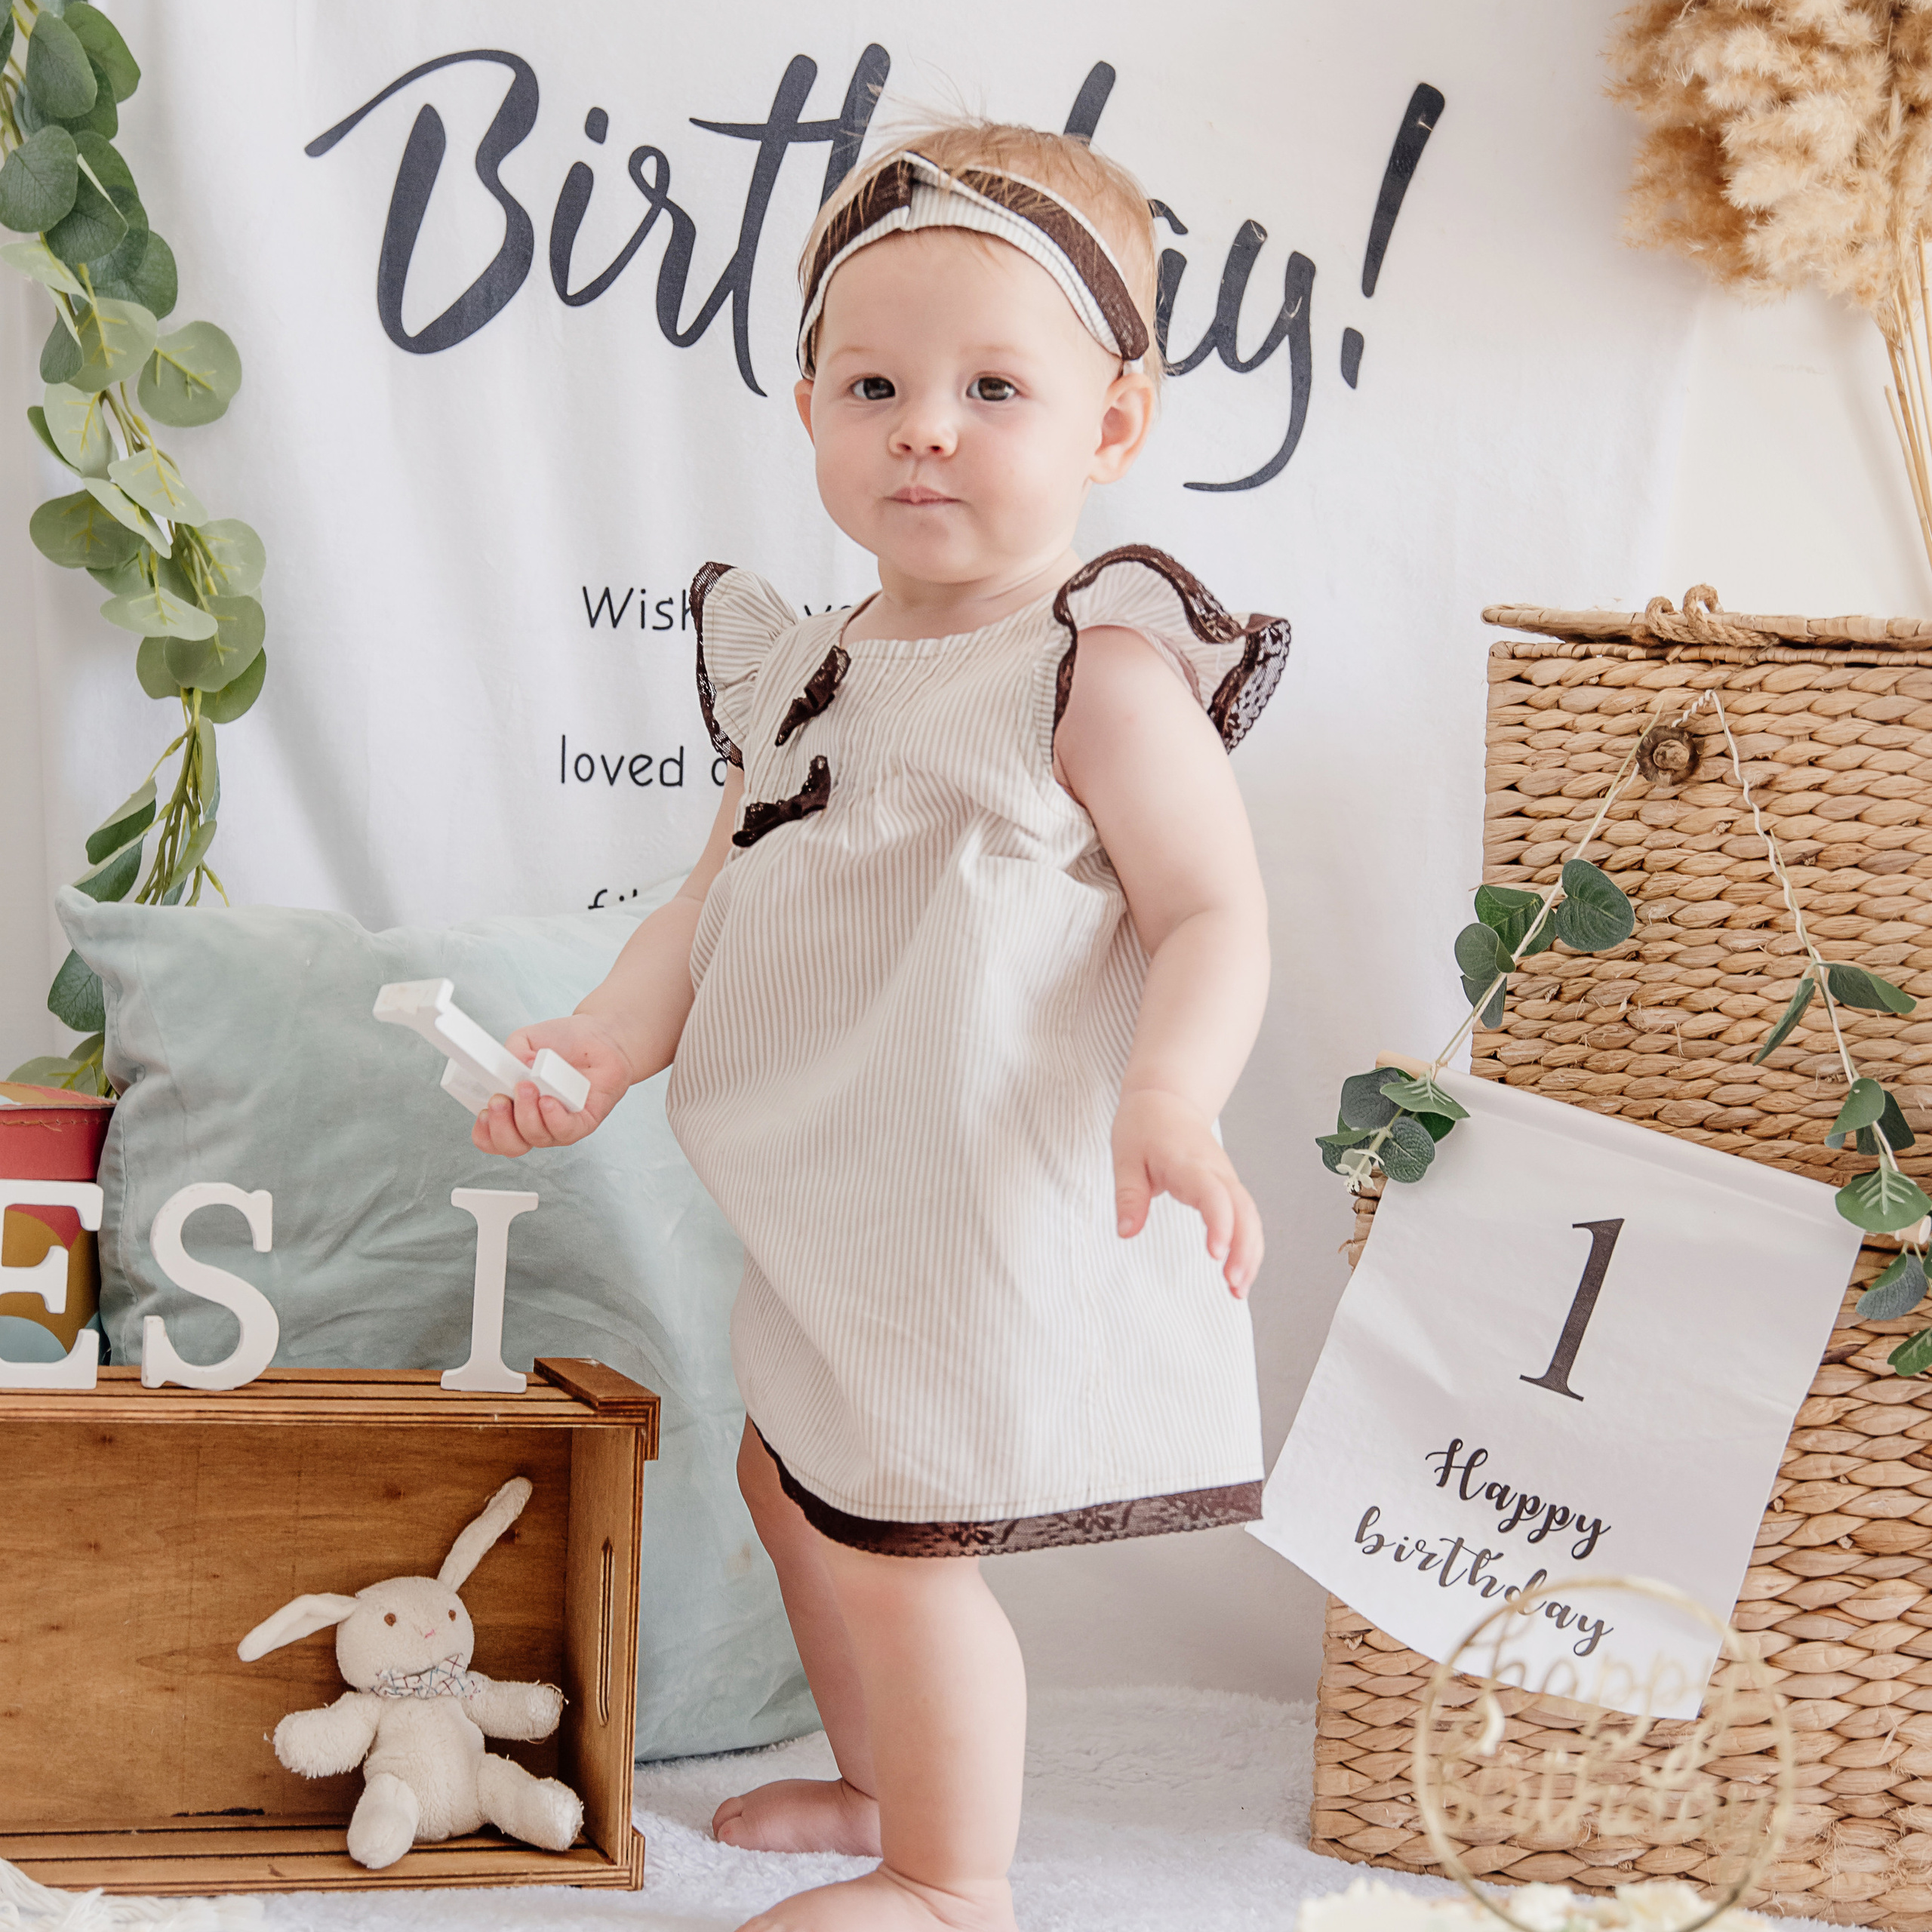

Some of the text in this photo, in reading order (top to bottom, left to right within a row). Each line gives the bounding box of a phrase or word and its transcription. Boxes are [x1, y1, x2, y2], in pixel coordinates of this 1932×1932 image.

[303, 43, 1446, 492] Birty!
[561, 734, 685, 787] loved
[1518, 1217, 1626, 1402] 1
[1425, 1438, 1612, 1561] Happy
[1354, 1506, 1615, 1657] birthday
